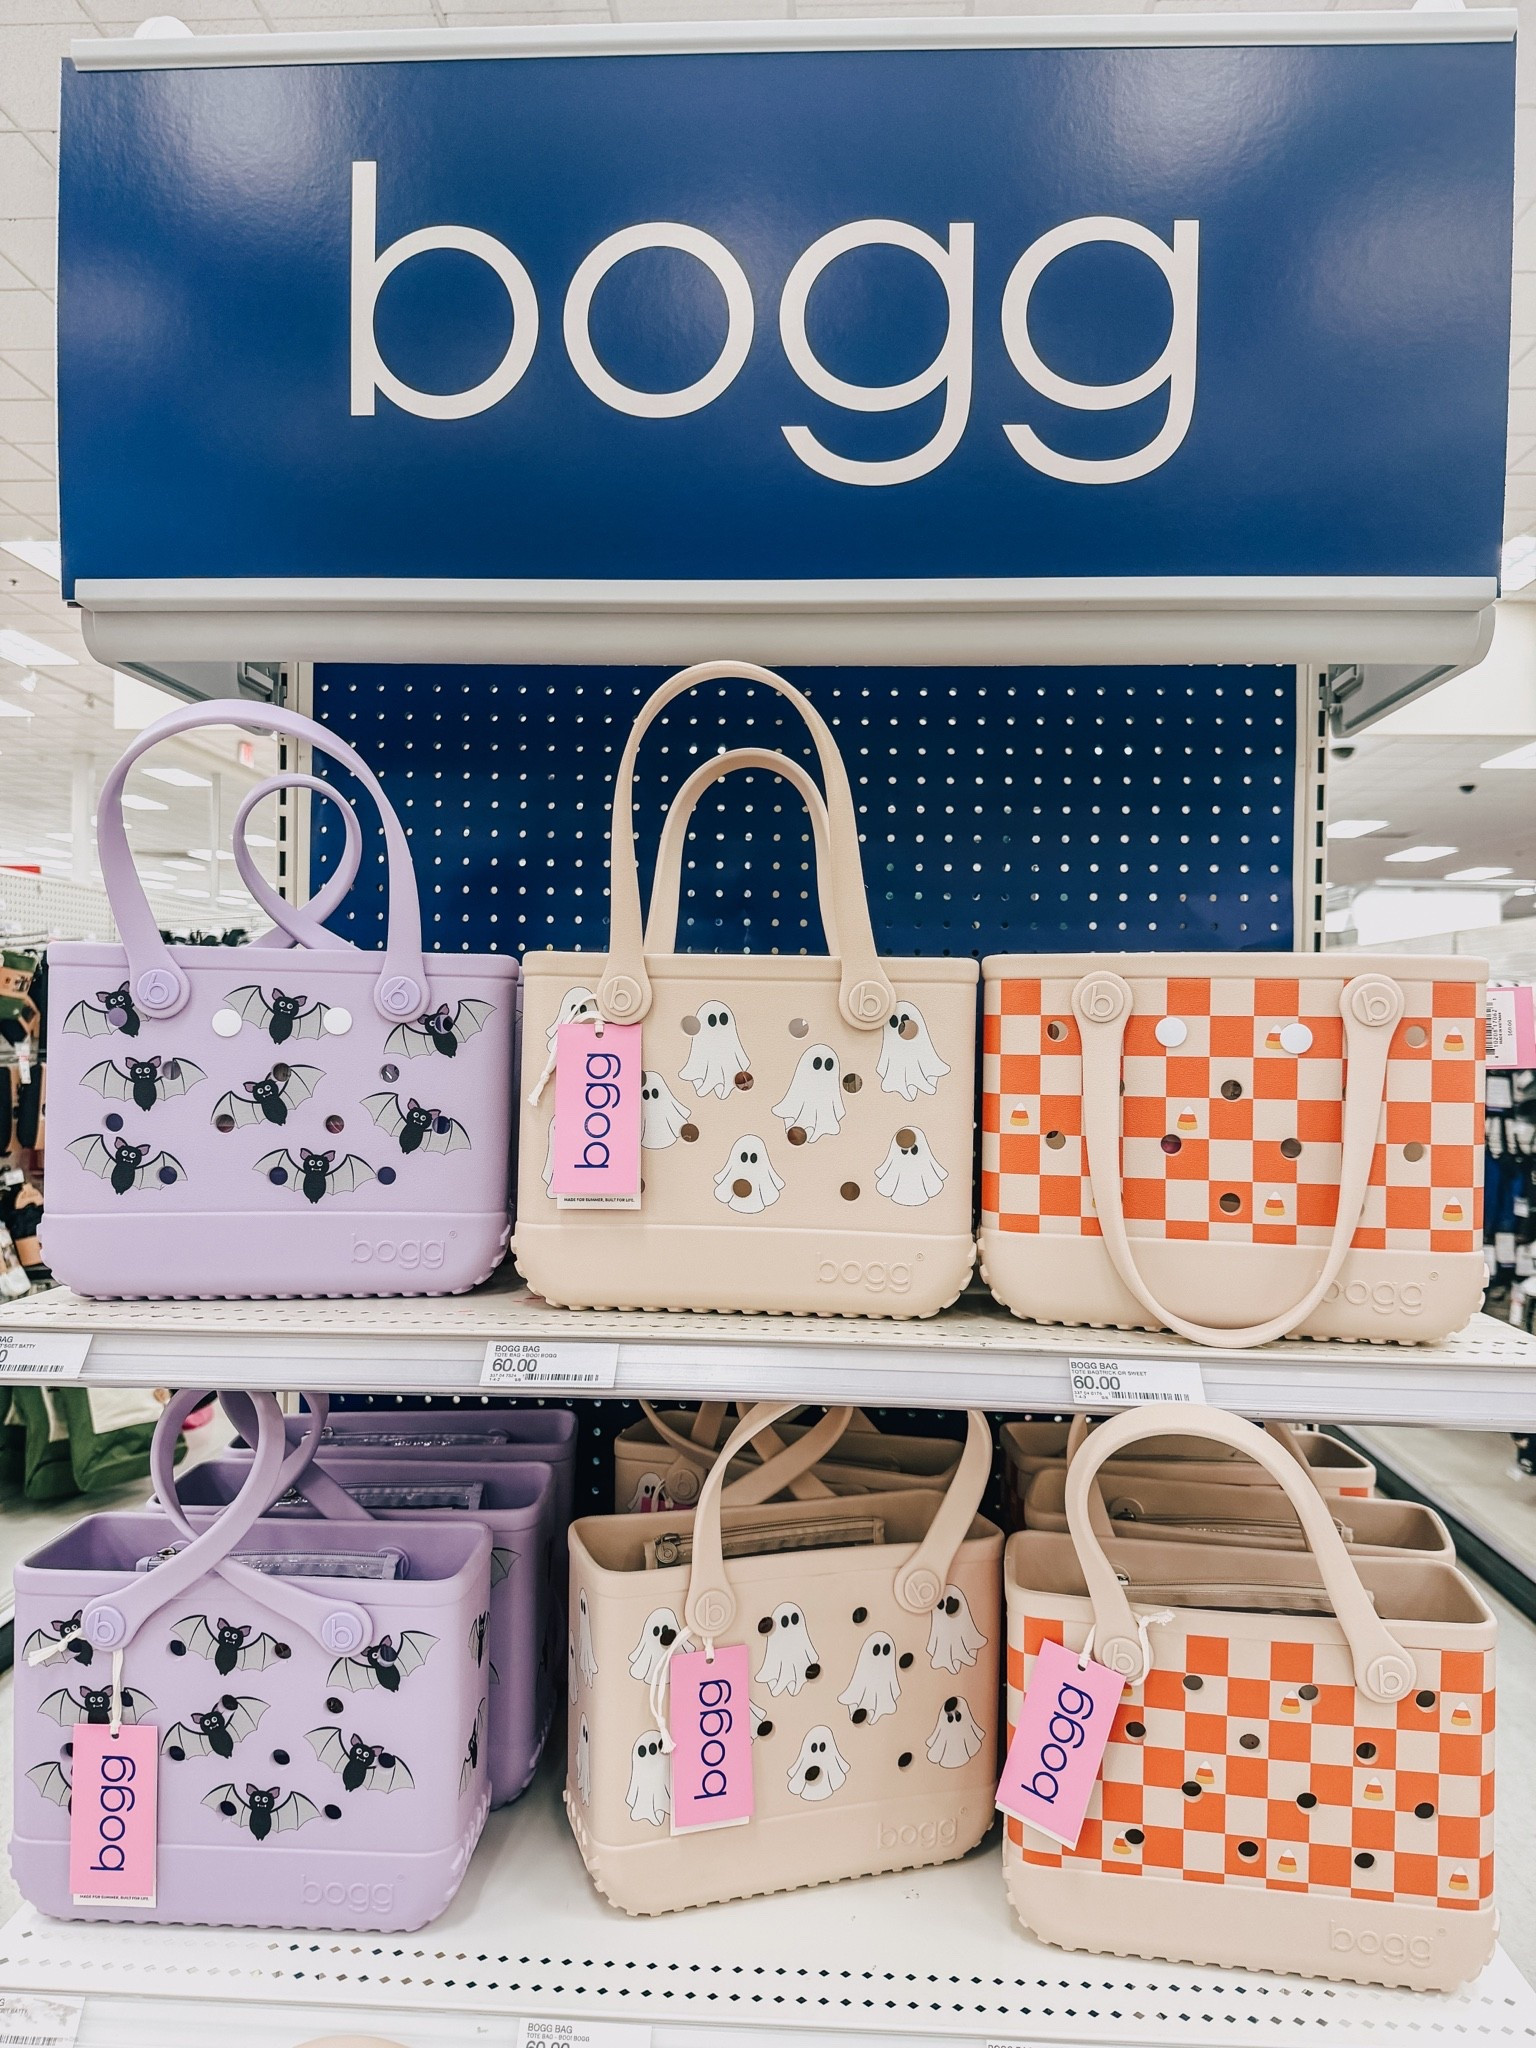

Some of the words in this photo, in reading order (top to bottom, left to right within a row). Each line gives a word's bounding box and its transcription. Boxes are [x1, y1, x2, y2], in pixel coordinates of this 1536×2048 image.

[350, 160, 1199, 486] bogg
[574, 1053, 622, 1168] bogg
[492, 1358, 538, 1372] 60.00
[522, 1345, 540, 1353] BAG
[1071, 1362, 1097, 1370] BOGG
[1099, 1362, 1118, 1370] BAG
[1073, 1375, 1120, 1390] 60.00
[694, 1679, 733, 1800] bogg
[1021, 1682, 1094, 1804] bogg
[90, 1755, 136, 1871] bogg
[527, 2023, 552, 2033] BOGG
[555, 2025, 573, 2034] BAG
